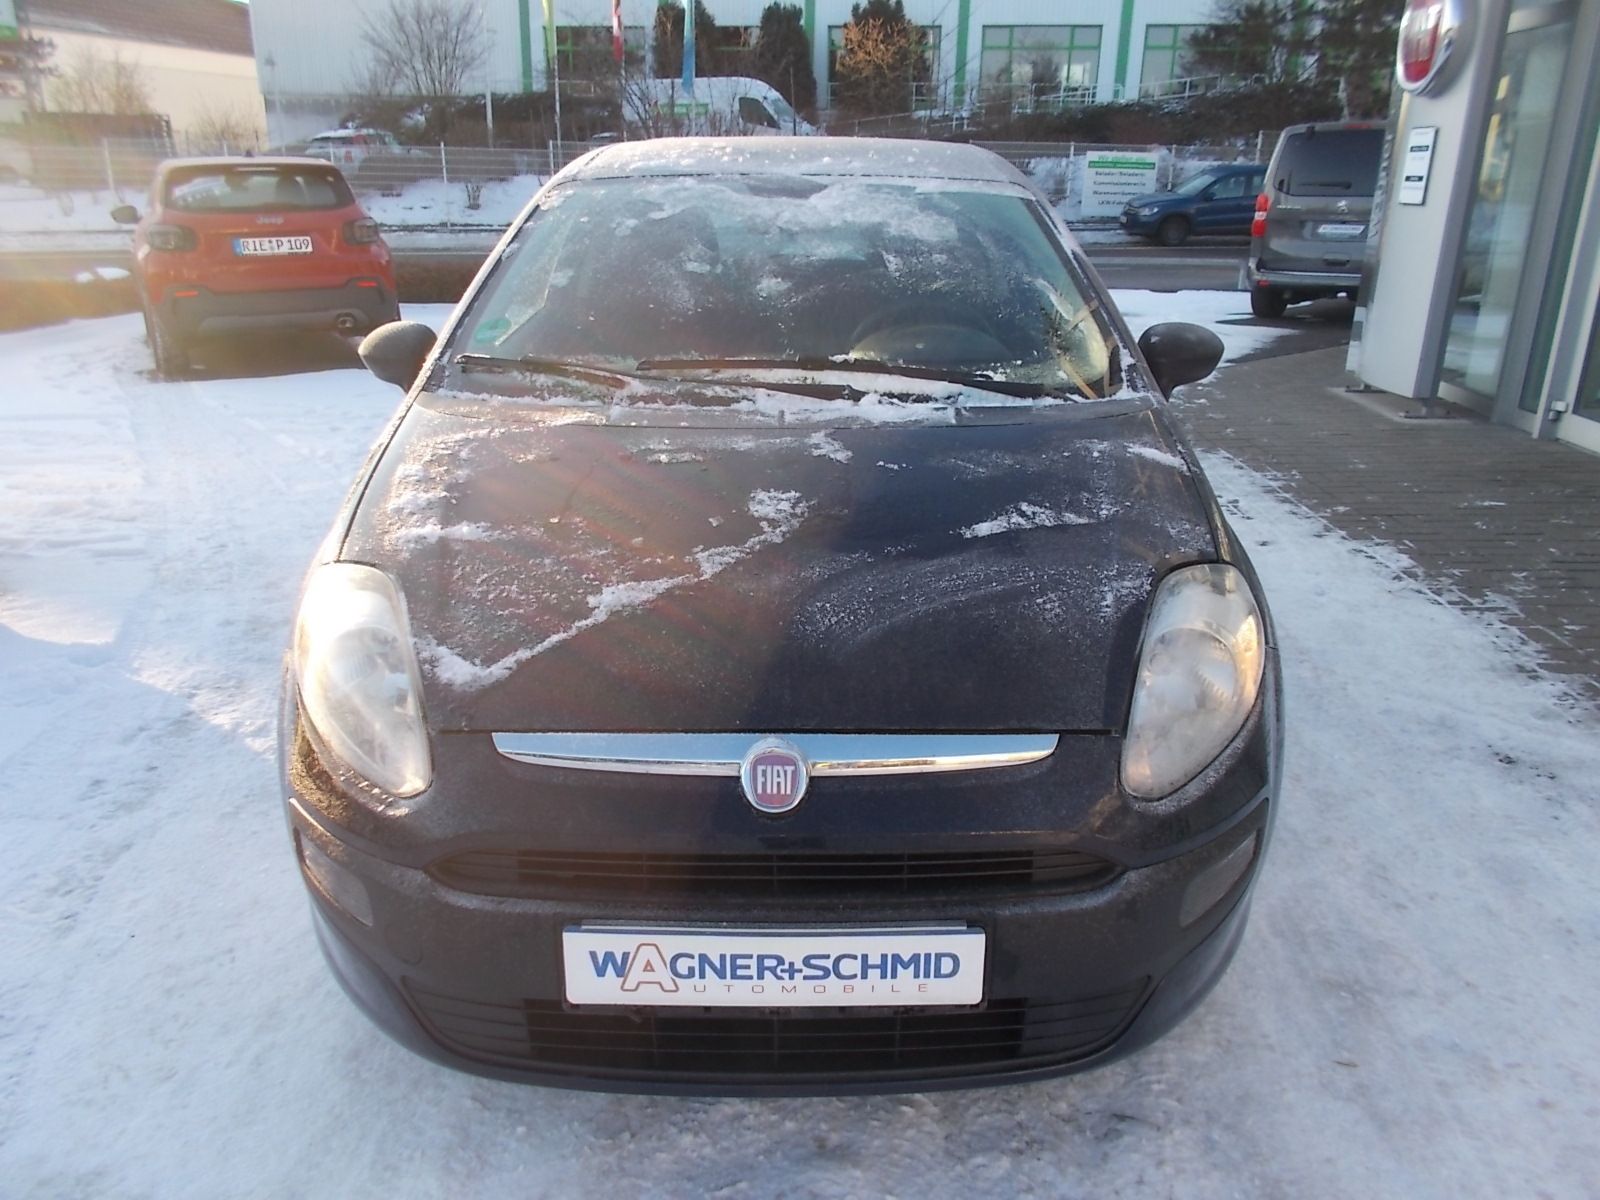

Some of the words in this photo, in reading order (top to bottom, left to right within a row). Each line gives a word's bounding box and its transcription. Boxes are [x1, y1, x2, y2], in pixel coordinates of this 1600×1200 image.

[241, 240, 267, 252] RIE
[275, 239, 284, 251] P
[287, 238, 310, 251] 109
[757, 765, 795, 795] FIAT
